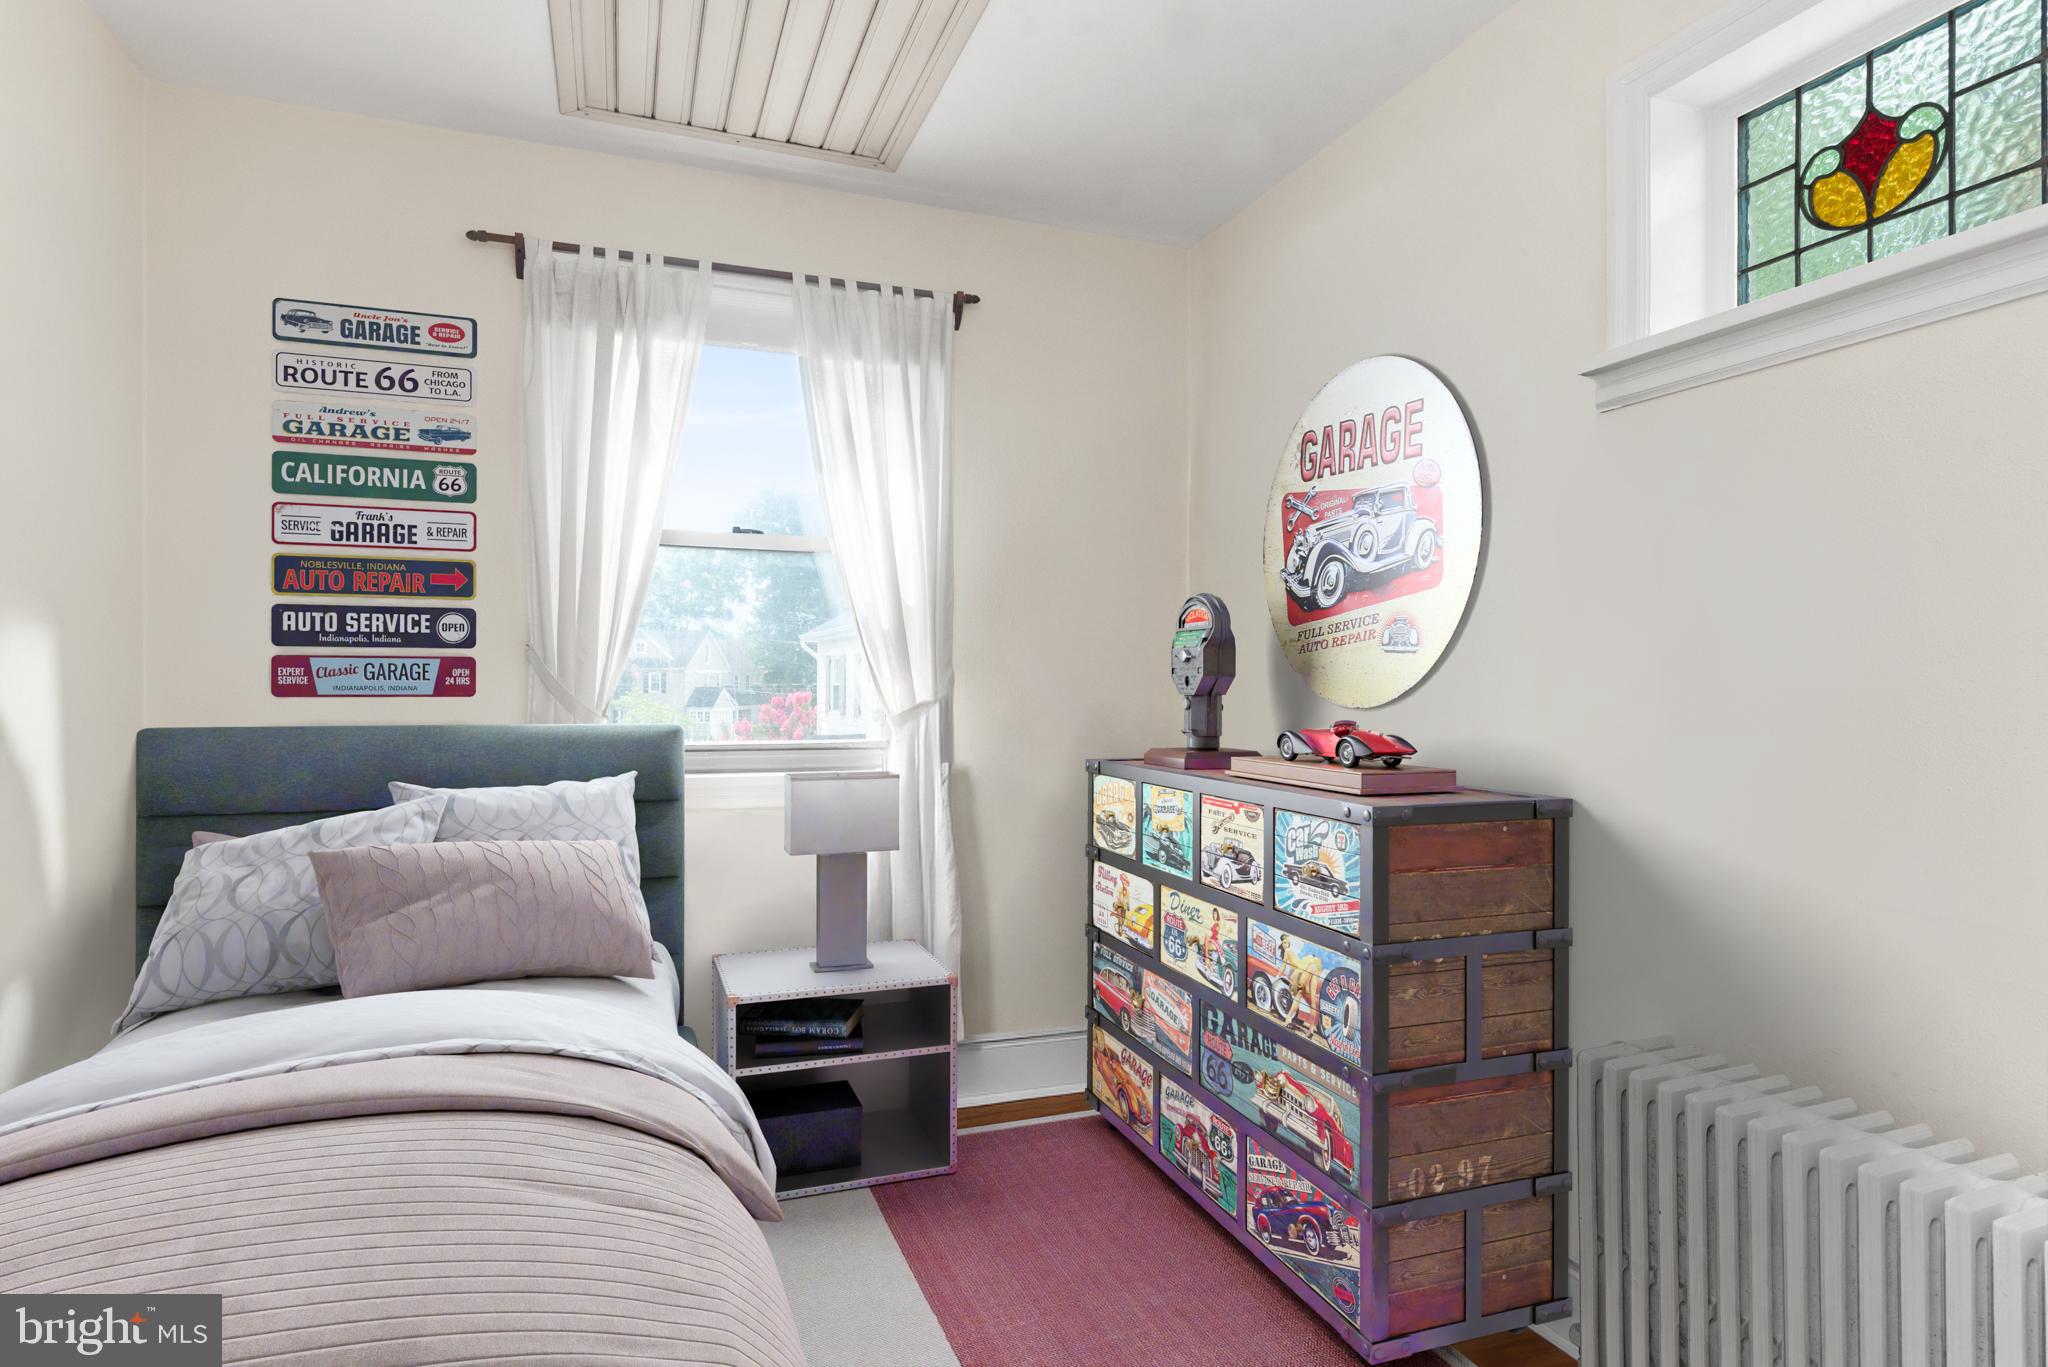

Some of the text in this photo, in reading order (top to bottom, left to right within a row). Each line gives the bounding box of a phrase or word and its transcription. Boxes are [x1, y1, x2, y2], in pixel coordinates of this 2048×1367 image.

[353, 312, 409, 324] Uncle Jon's
[340, 319, 420, 345] GARAGE
[296, 359, 356, 369] HISTORIC
[284, 365, 419, 392] ROUTE 66
[432, 371, 459, 379] FROM
[424, 379, 465, 388] CHICAGO
[319, 406, 376, 417] Andrew's
[283, 413, 410, 427] FULL SERVICE
[282, 419, 410, 441] GARAGE
[312, 438, 357, 447] CHANGES
[1299, 398, 1425, 483] GARAGE
[281, 461, 427, 489] CALIFORNIA
[439, 478, 461, 491] 66
[1320, 496, 1346, 510] ORIGINAL
[355, 511, 393, 522] Frank's
[281, 520, 320, 531] SERVICE
[330, 521, 417, 544] GARAGE
[427, 527, 467, 538] & REPAIR
[300, 560, 364, 570] NOBLESVILLE,
[282, 569, 425, 593] AUTO REPAIR
[282, 612, 430, 633] AUTO SERVICE
[441, 623, 465, 632] OPEN
[1297, 613, 1380, 643] FULL SERVICE
[1298, 629, 1377, 655] AUTO REPAIR
[278, 668, 304, 676] EXPERT
[316, 663, 430, 681] Classic GARAGE
[278, 676, 309, 685] SERVICE
[445, 677, 470, 685] 24 HRS
[1223, 827, 1257, 839] SERVICE
[1169, 892, 1203, 924] Diner
[1165, 915, 1183, 929] ROUTE
[1168, 936, 1182, 957] 66
[1100, 948, 1111, 960] FULL
[1150, 991, 1178, 1025] GARAGE
[1202, 1005, 1279, 1061] GARAGE
[1206, 1055, 1228, 1090] 66
[1282, 1049, 1307, 1068] PARTS
[1321, 1068, 1357, 1097] SERVICE
[1166, 1087, 1194, 1107] GARAGE
[1215, 1136, 1227, 1155] 66
